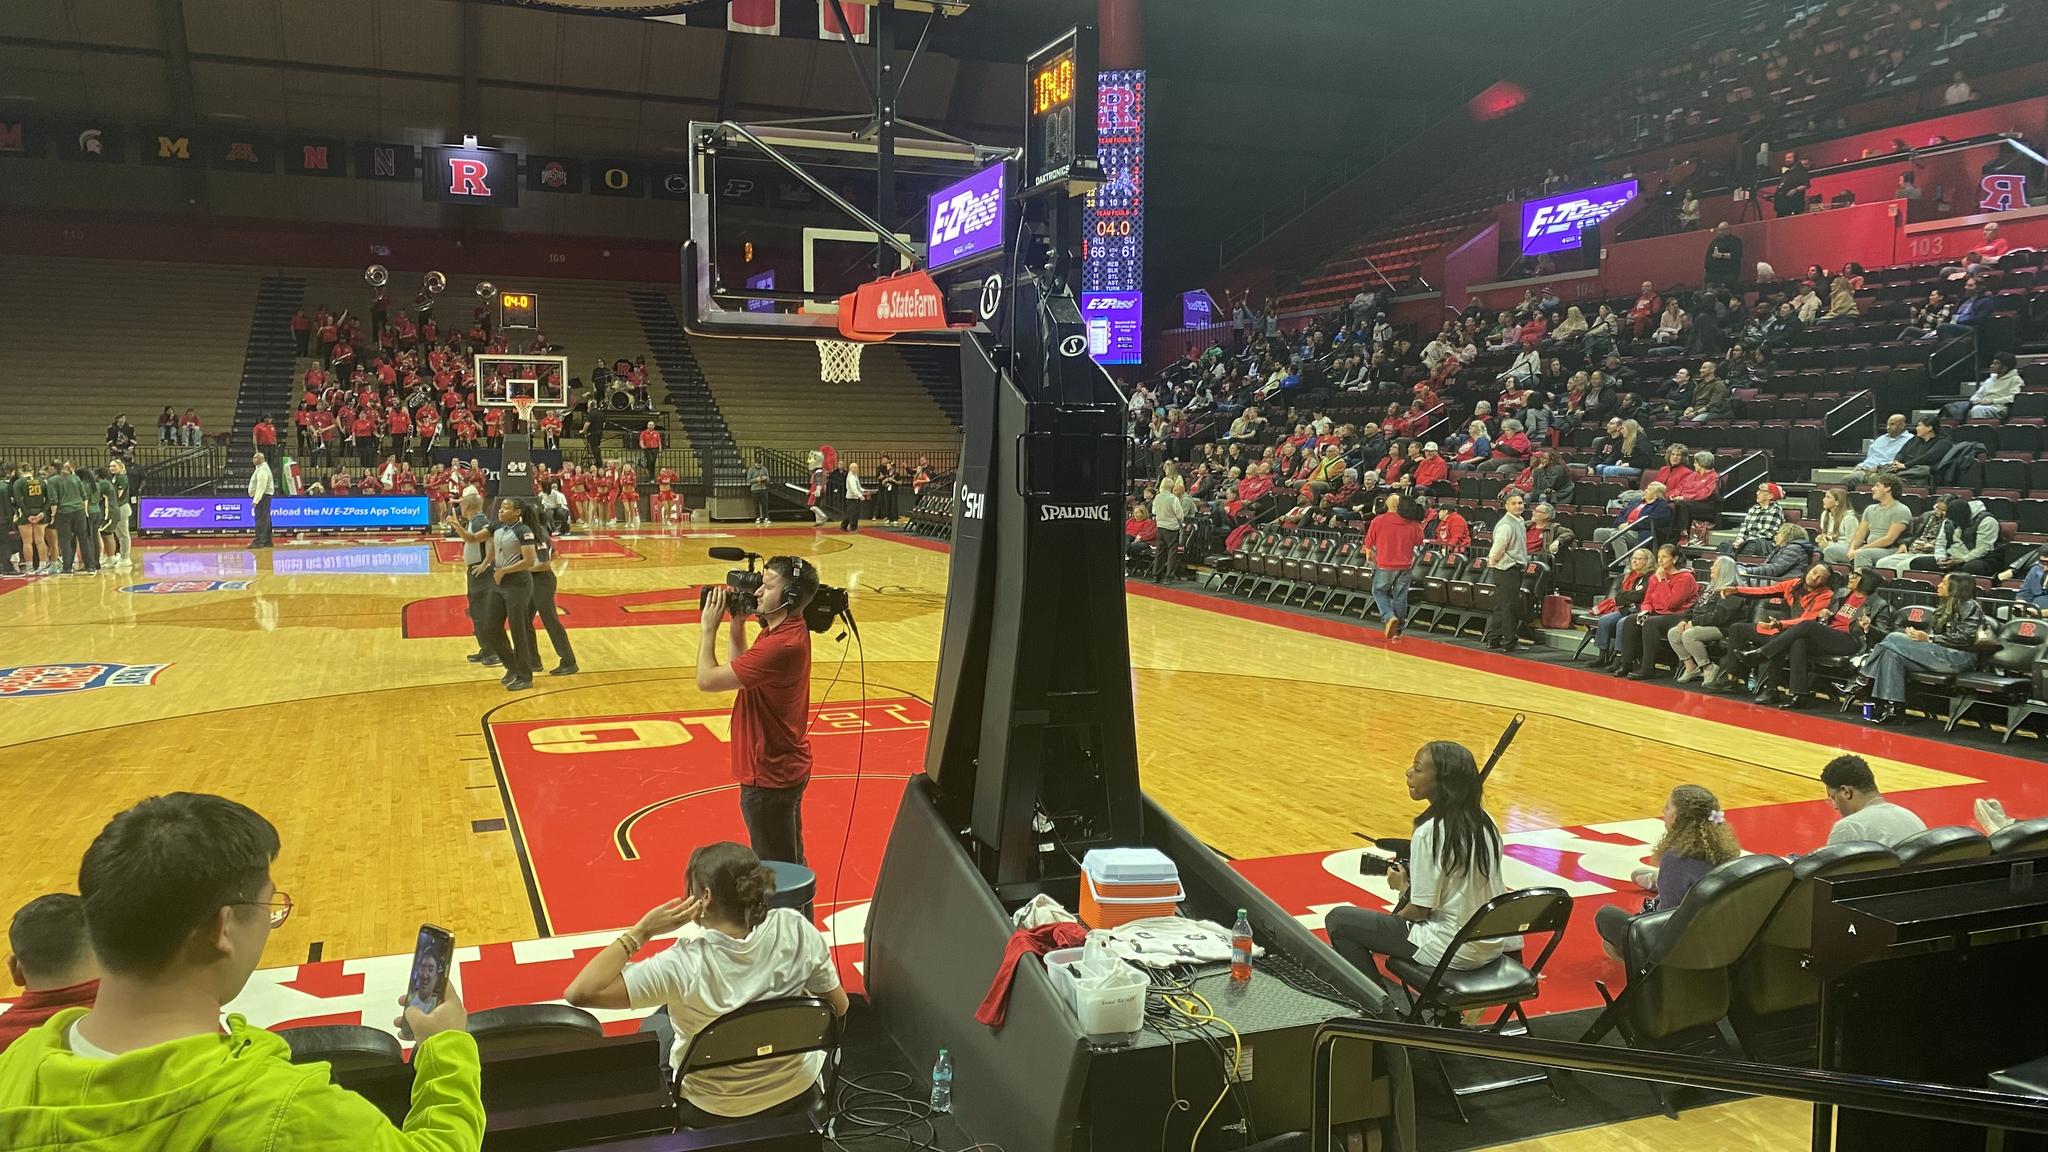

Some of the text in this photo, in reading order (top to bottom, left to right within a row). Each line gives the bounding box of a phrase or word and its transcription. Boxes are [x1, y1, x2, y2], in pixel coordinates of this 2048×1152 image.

[158, 136, 190, 159] M
[304, 145, 328, 169] N
[374, 148, 394, 176] N
[449, 158, 491, 197] R
[604, 169, 629, 190] O
[723, 179, 754, 197] P
[930, 188, 1000, 247] E-ZPass
[1097, 221, 1130, 236] 04.0
[1091, 247, 1106, 257] 66
[1122, 246, 1135, 257] 61
[1910, 237, 1944, 257] 103
[549, 254, 566, 263] 109
[1087, 298, 1135, 309] E-ZPass
[29, 485, 42, 496] 20
[149, 507, 203, 518] E-ZPass
[304, 506, 319, 516] the
[322, 507, 332, 516] NJ
[334, 507, 368, 516] E-ZPass
[370, 507, 388, 517] App
[390, 507, 420, 516] Today!
[1041, 504, 1109, 522] SPALDING
[1908, 608, 1925, 622] R
[2017, 622, 2036, 637] R
[1848, 924, 1856, 935] A
